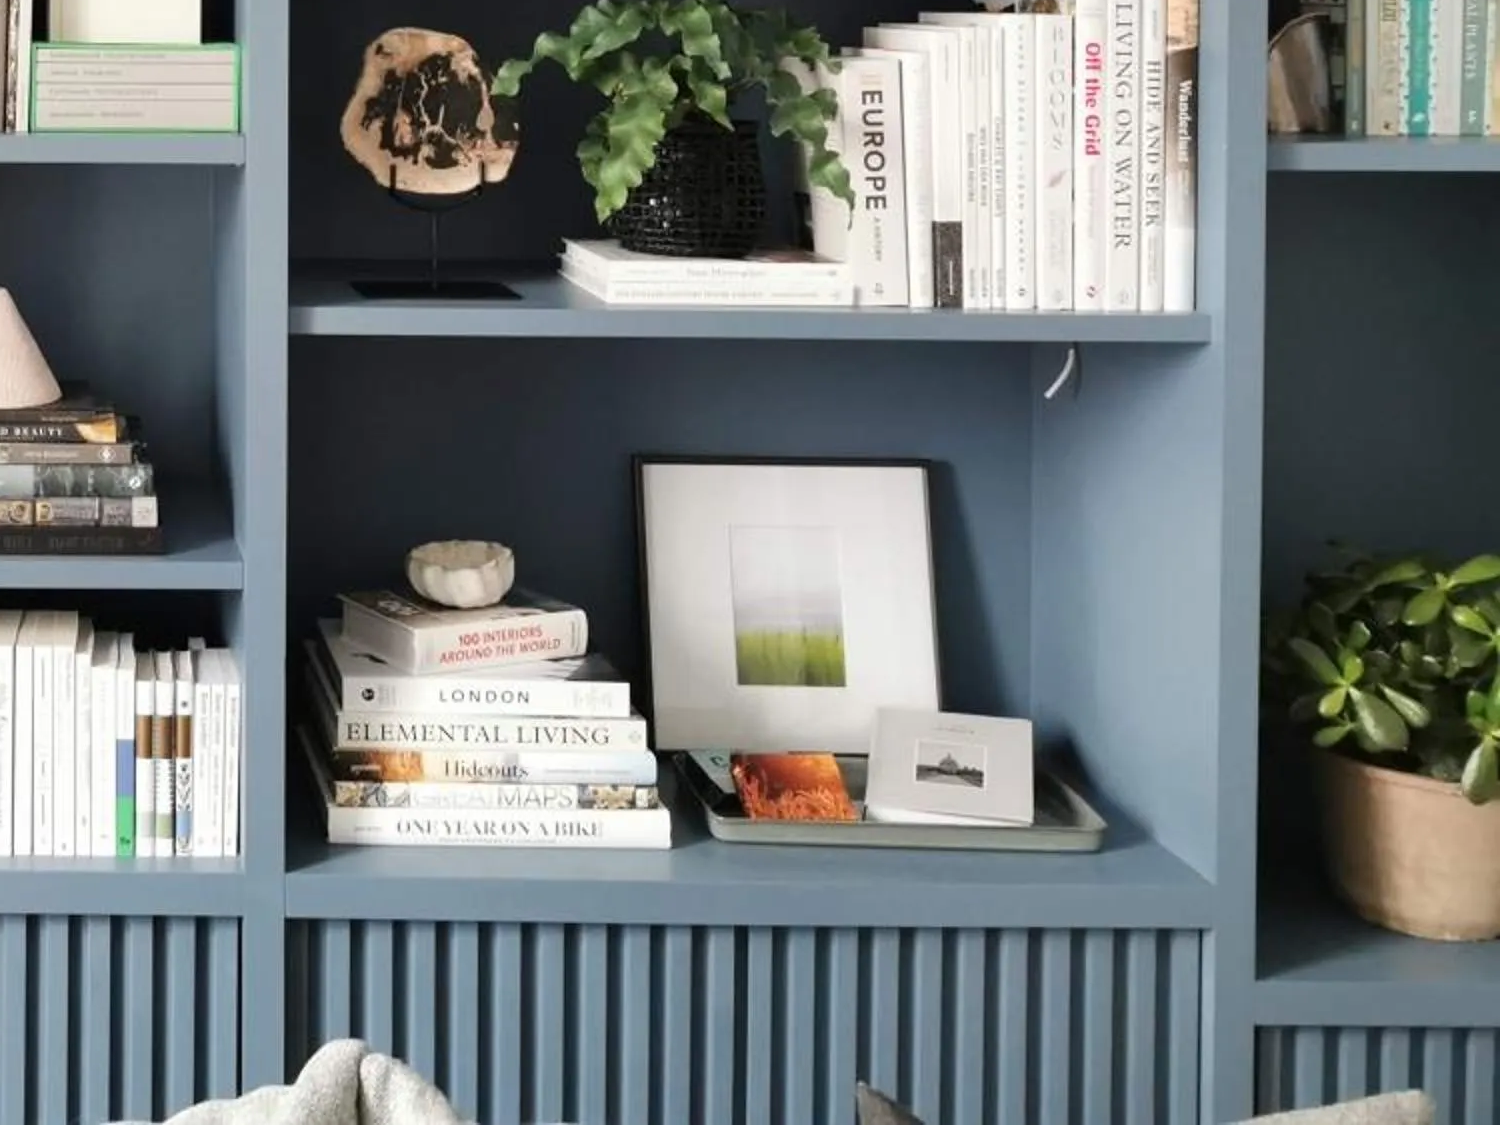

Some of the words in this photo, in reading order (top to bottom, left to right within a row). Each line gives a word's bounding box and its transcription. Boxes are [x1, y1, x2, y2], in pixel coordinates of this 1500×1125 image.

[1084, 42, 1102, 71] Off
[1114, 3, 1134, 100] LIVING
[1084, 77, 1102, 108] the
[1145, 59, 1162, 113] HIDE
[1084, 113, 1102, 157] Grid
[1114, 108, 1133, 147] ON
[1178, 79, 1194, 163] Wanderlust
[860, 89, 887, 211] EUROPE
[1145, 121, 1162, 165] AND
[1113, 156, 1133, 250] WATER
[1145, 171, 1162, 228] SEEK
[440, 646, 493, 664] AROUND
[496, 644, 516, 658] THE
[520, 638, 562, 655] WORLD
[459, 633, 481, 647] 100
[482, 625, 543, 643] INTERIORS
[439, 690, 532, 705] LONDON
[346, 723, 508, 744] ELEMENTAL
[516, 725, 611, 746] LIVING
[443, 758, 530, 779] Hideouts
[497, 786, 574, 809] MAPS
[396, 819, 438, 837] ONE
[441, 819, 497, 837] YEAR
[500, 819, 532, 837] ON
[537, 819, 552, 837] A
[554, 819, 604, 838] BIKE
